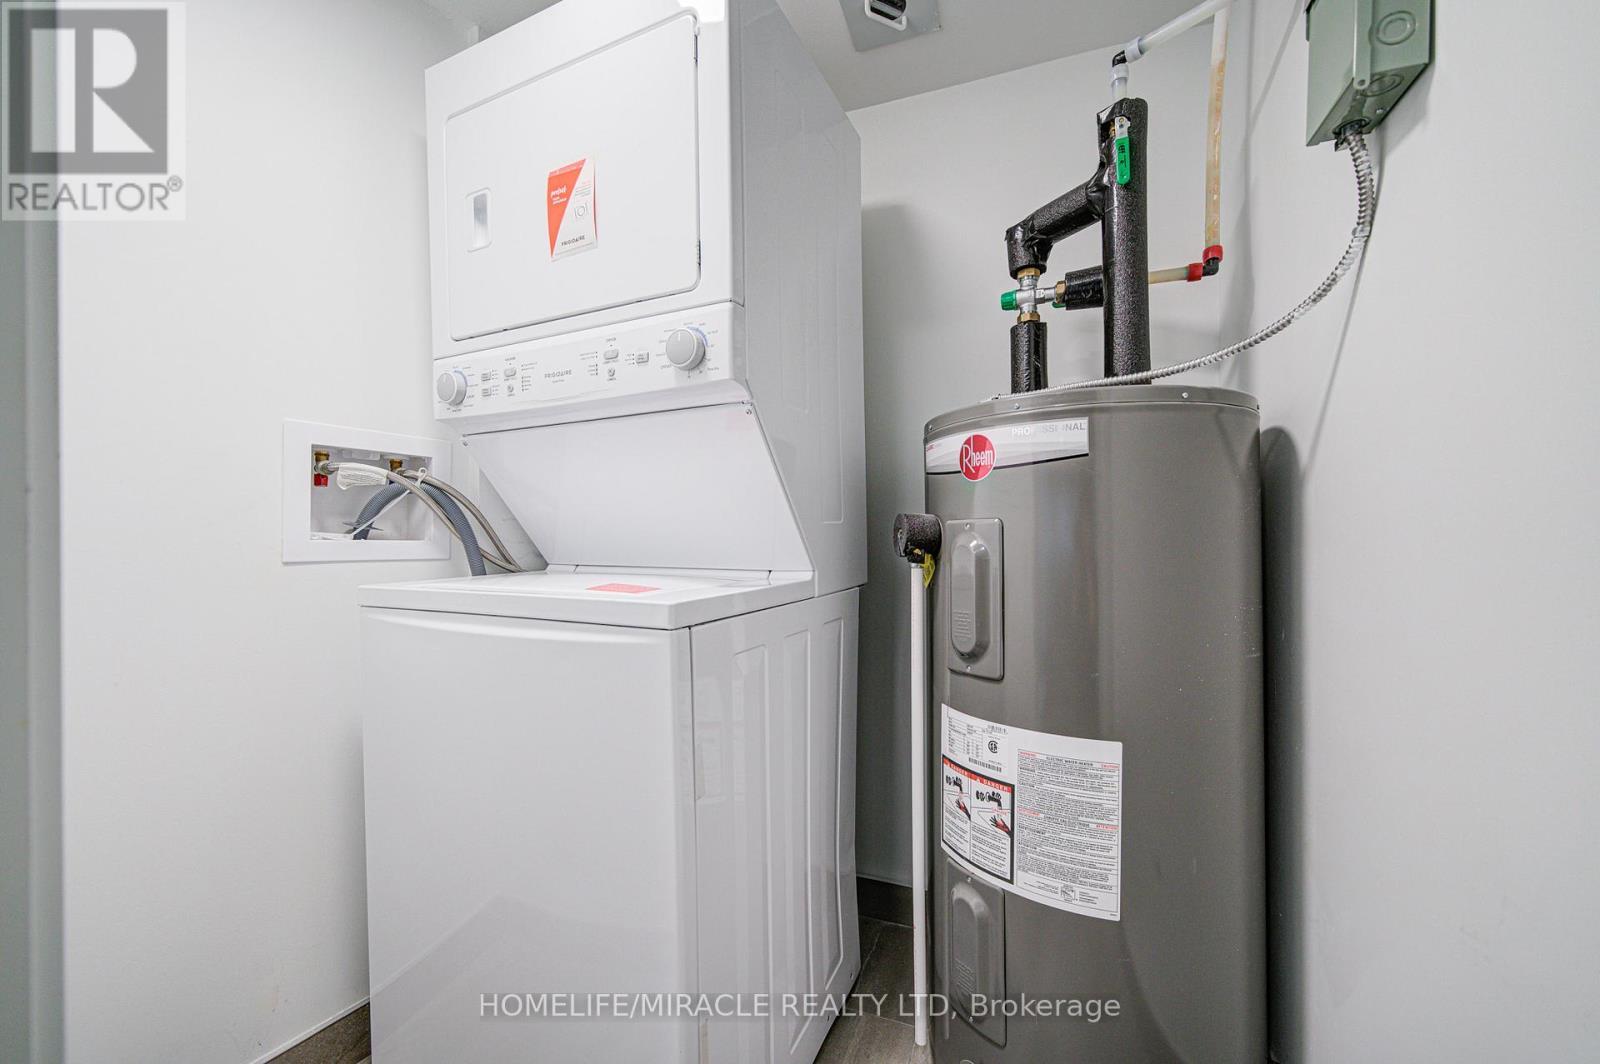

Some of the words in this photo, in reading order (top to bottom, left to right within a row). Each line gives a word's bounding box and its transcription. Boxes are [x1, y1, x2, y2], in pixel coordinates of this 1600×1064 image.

[561, 235, 585, 246] FRIGIDAIRE
[544, 369, 573, 379] FRIGIDAIRE
[962, 434, 994, 474] Rheem
[983, 779, 1009, 792] DANGER
